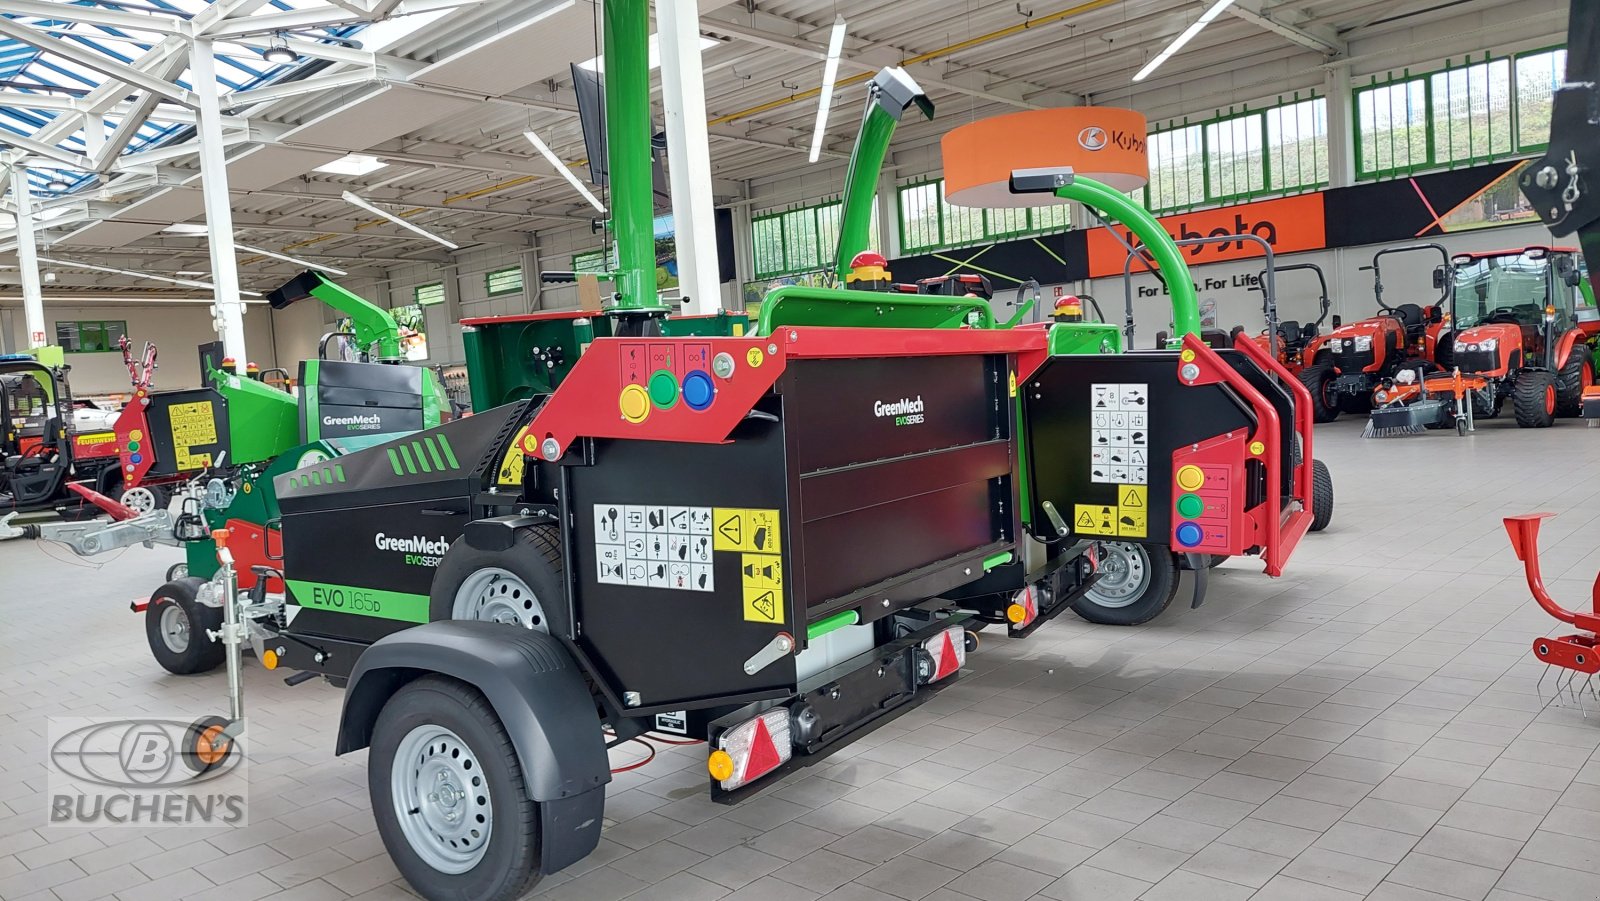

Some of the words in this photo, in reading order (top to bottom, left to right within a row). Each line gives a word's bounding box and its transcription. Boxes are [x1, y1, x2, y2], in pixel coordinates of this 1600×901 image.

[1138, 286, 1159, 298] For
[1205, 278, 1228, 290] For
[1232, 273, 1259, 287] Life
[873, 395, 925, 418] GreenMech
[323, 413, 381, 426] GreenMech
[895, 414, 925, 426] EVOSERIES
[374, 532, 451, 555] GreenMech
[405, 554, 444, 568] EVOSERI
[313, 587, 345, 608] EVO
